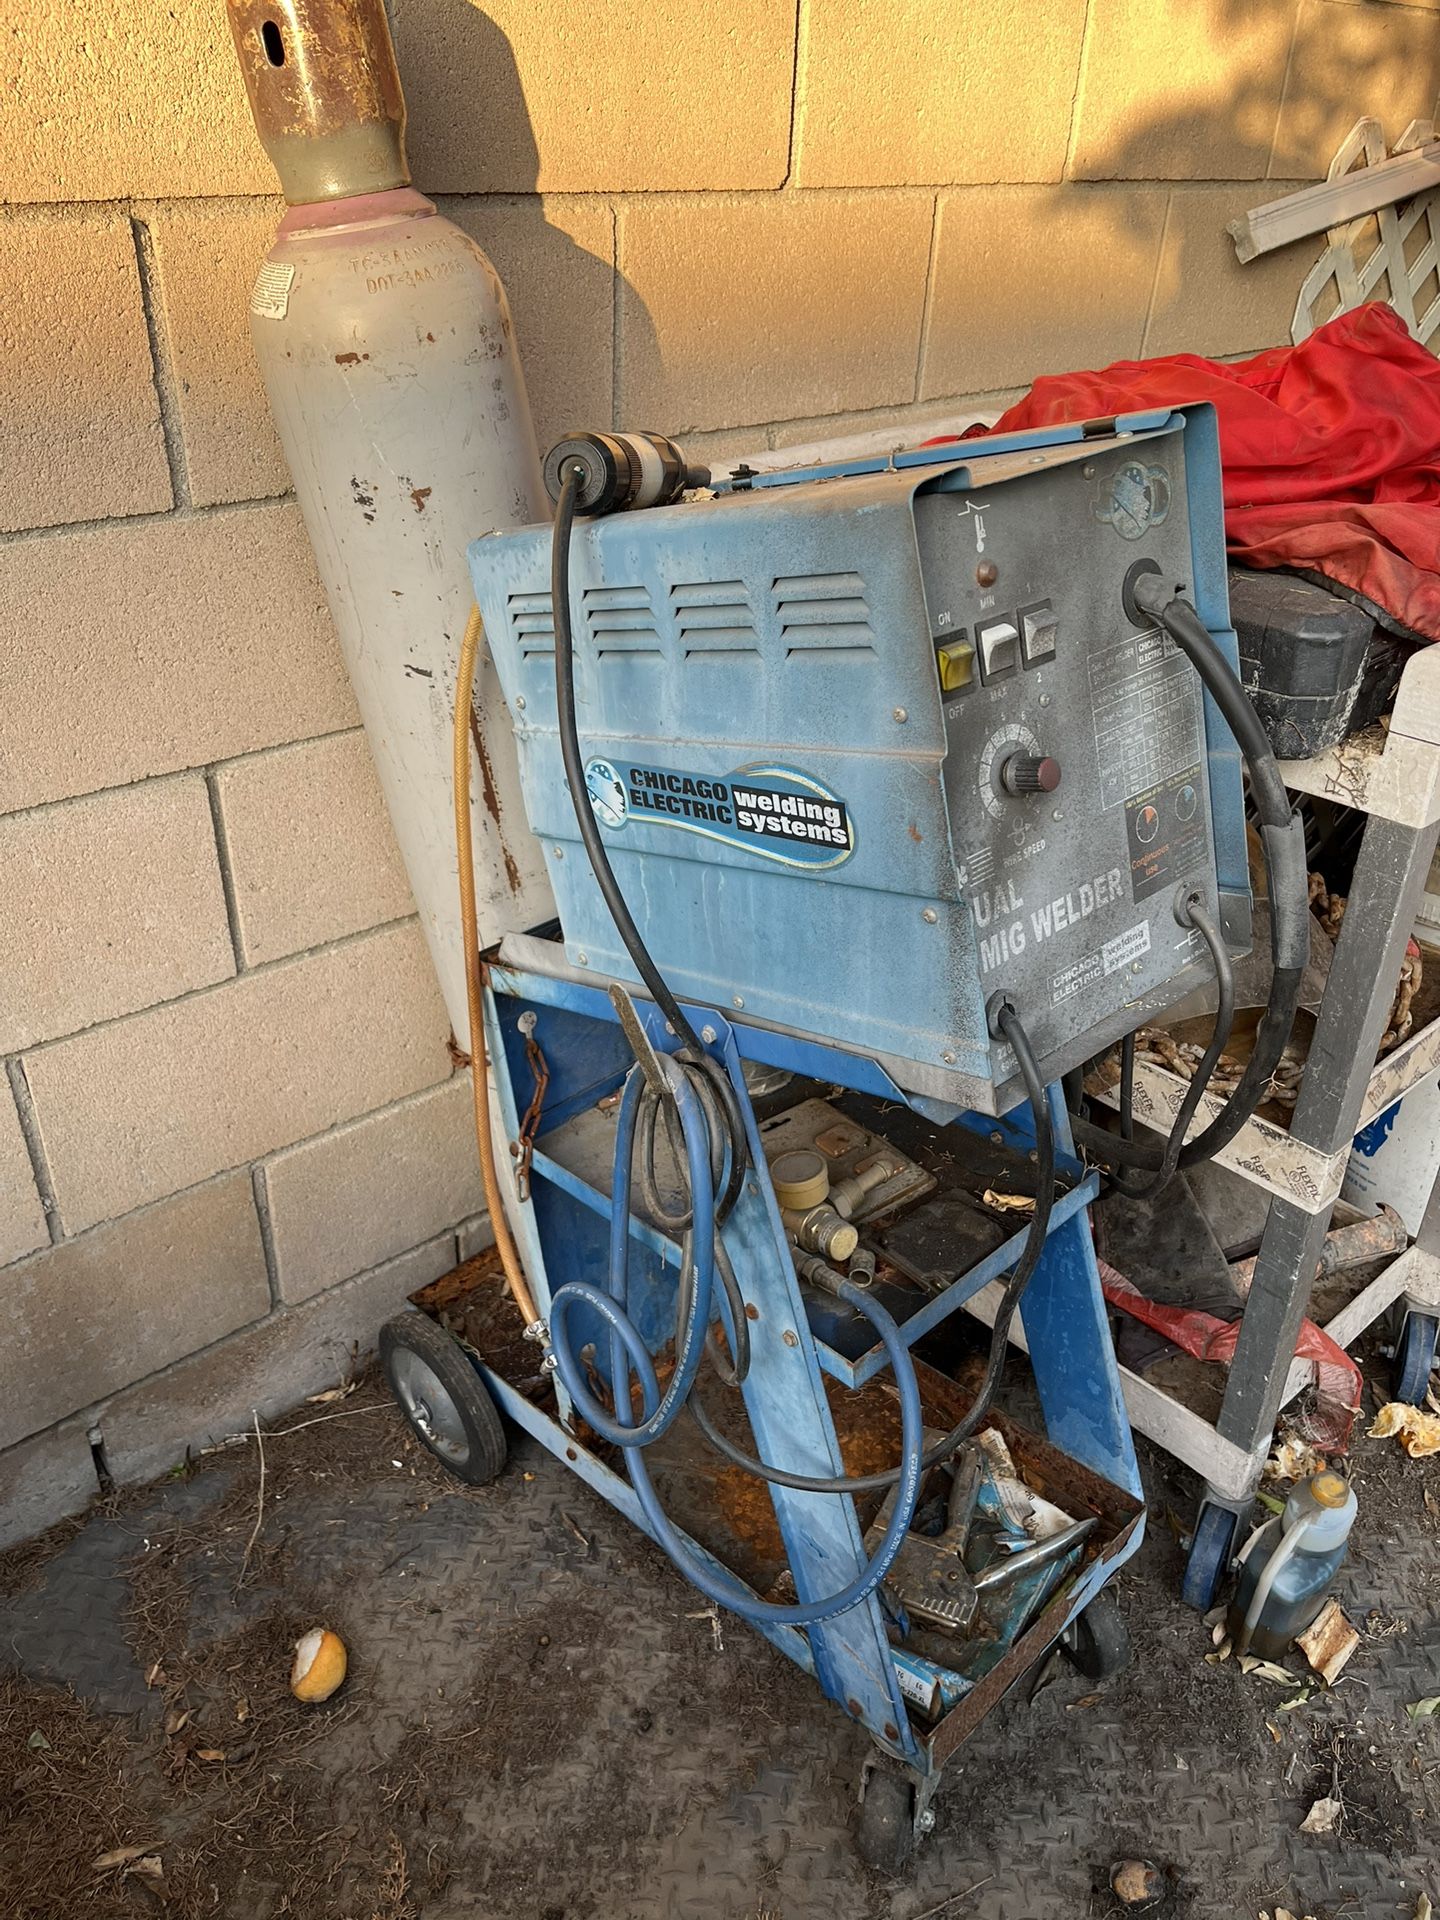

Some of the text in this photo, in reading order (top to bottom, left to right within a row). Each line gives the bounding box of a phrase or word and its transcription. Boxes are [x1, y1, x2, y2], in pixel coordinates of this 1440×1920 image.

[938, 611, 951, 626] ON
[980, 595, 995, 609] MIN
[1138, 648, 1162, 665] ELECTRIC
[1036, 672, 1042, 683] 2
[948, 704, 965, 719] OFF
[629, 768, 728, 801] CHICAGO
[630, 789, 733, 825] ELECTRIC
[733, 790, 840, 827] welding
[738, 809, 848, 845] systems
[1023, 839, 1046, 859] SPEED
[973, 878, 1025, 928] UAL
[980, 867, 1124, 974] MIG WELDER
[1107, 930, 1144, 956] welding
[1053, 954, 1100, 988] CHICAGO
[1053, 967, 1102, 1003] ELECTRIC
